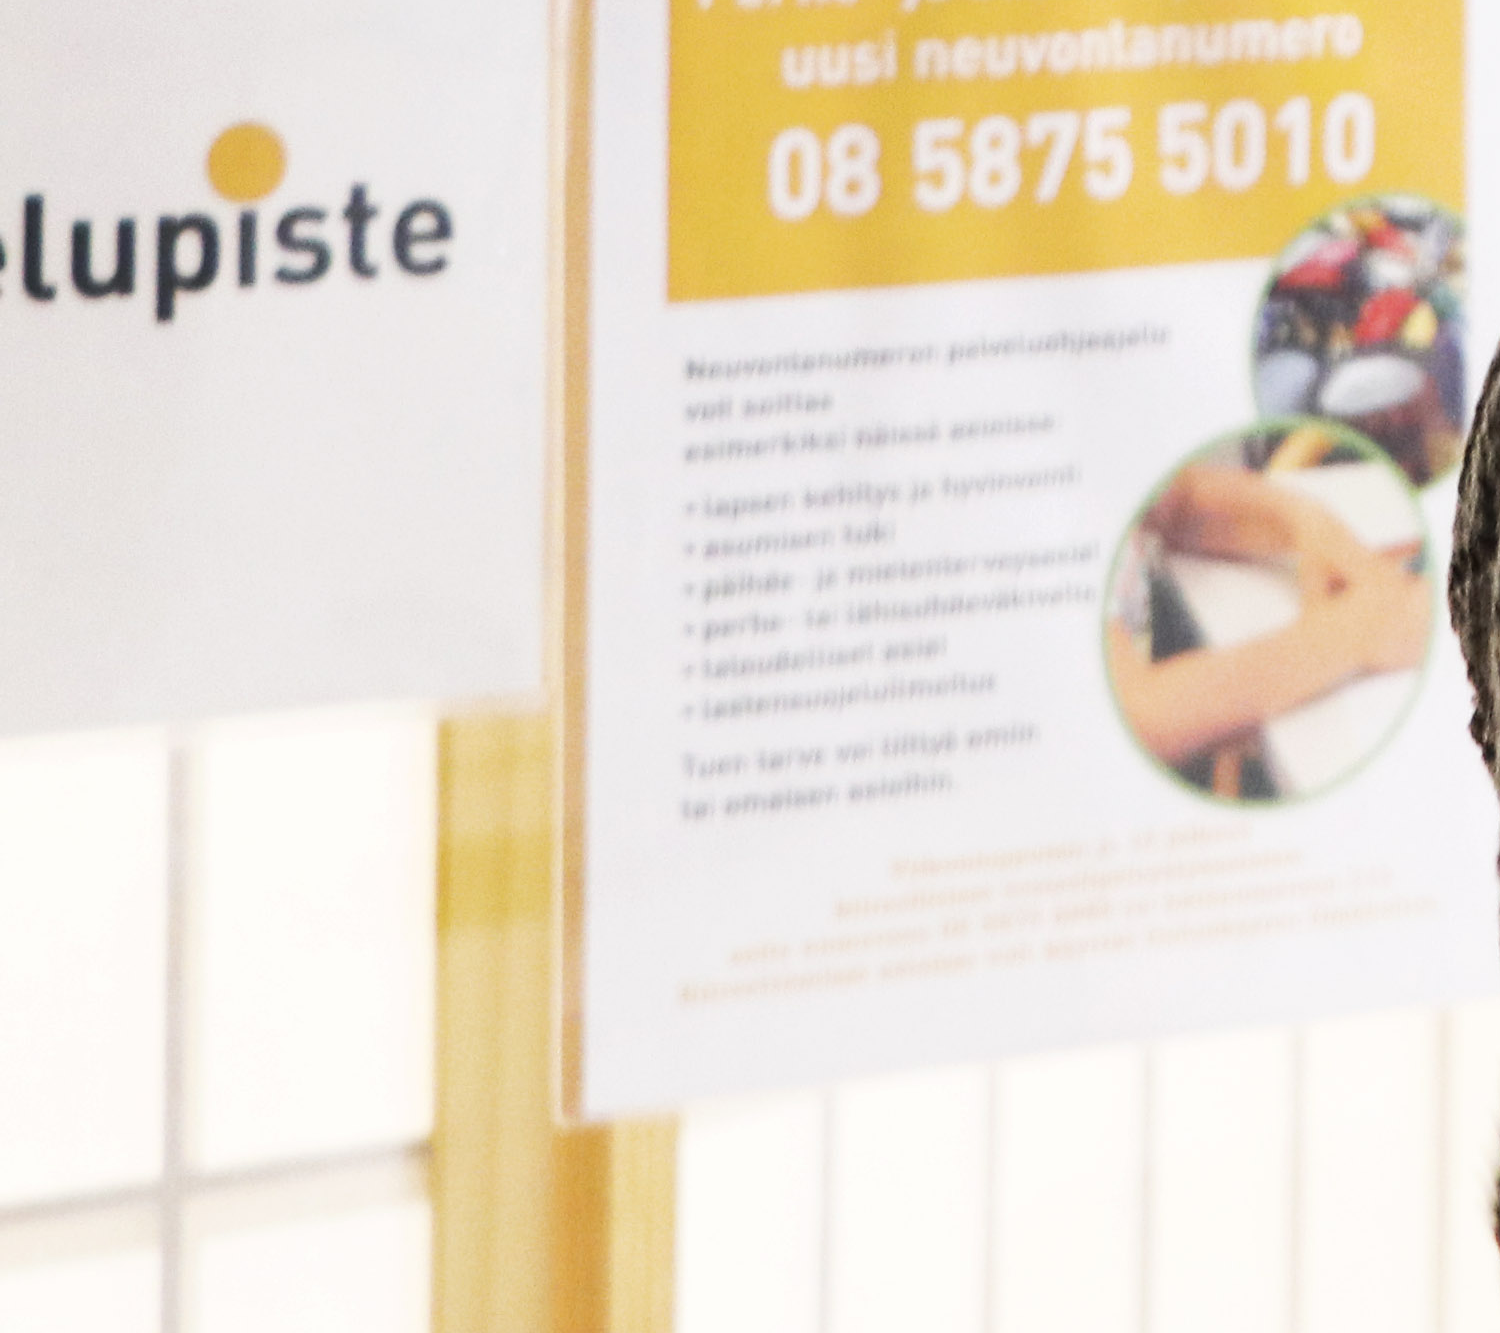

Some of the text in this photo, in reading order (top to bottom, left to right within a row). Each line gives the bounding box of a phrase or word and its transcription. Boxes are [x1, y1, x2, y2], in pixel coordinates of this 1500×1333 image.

[781, 13, 1366, 89] uusi neuvontanumero
[767, 91, 1377, 221] 08 5875 5010
[0, 121, 456, 324] lupiste
